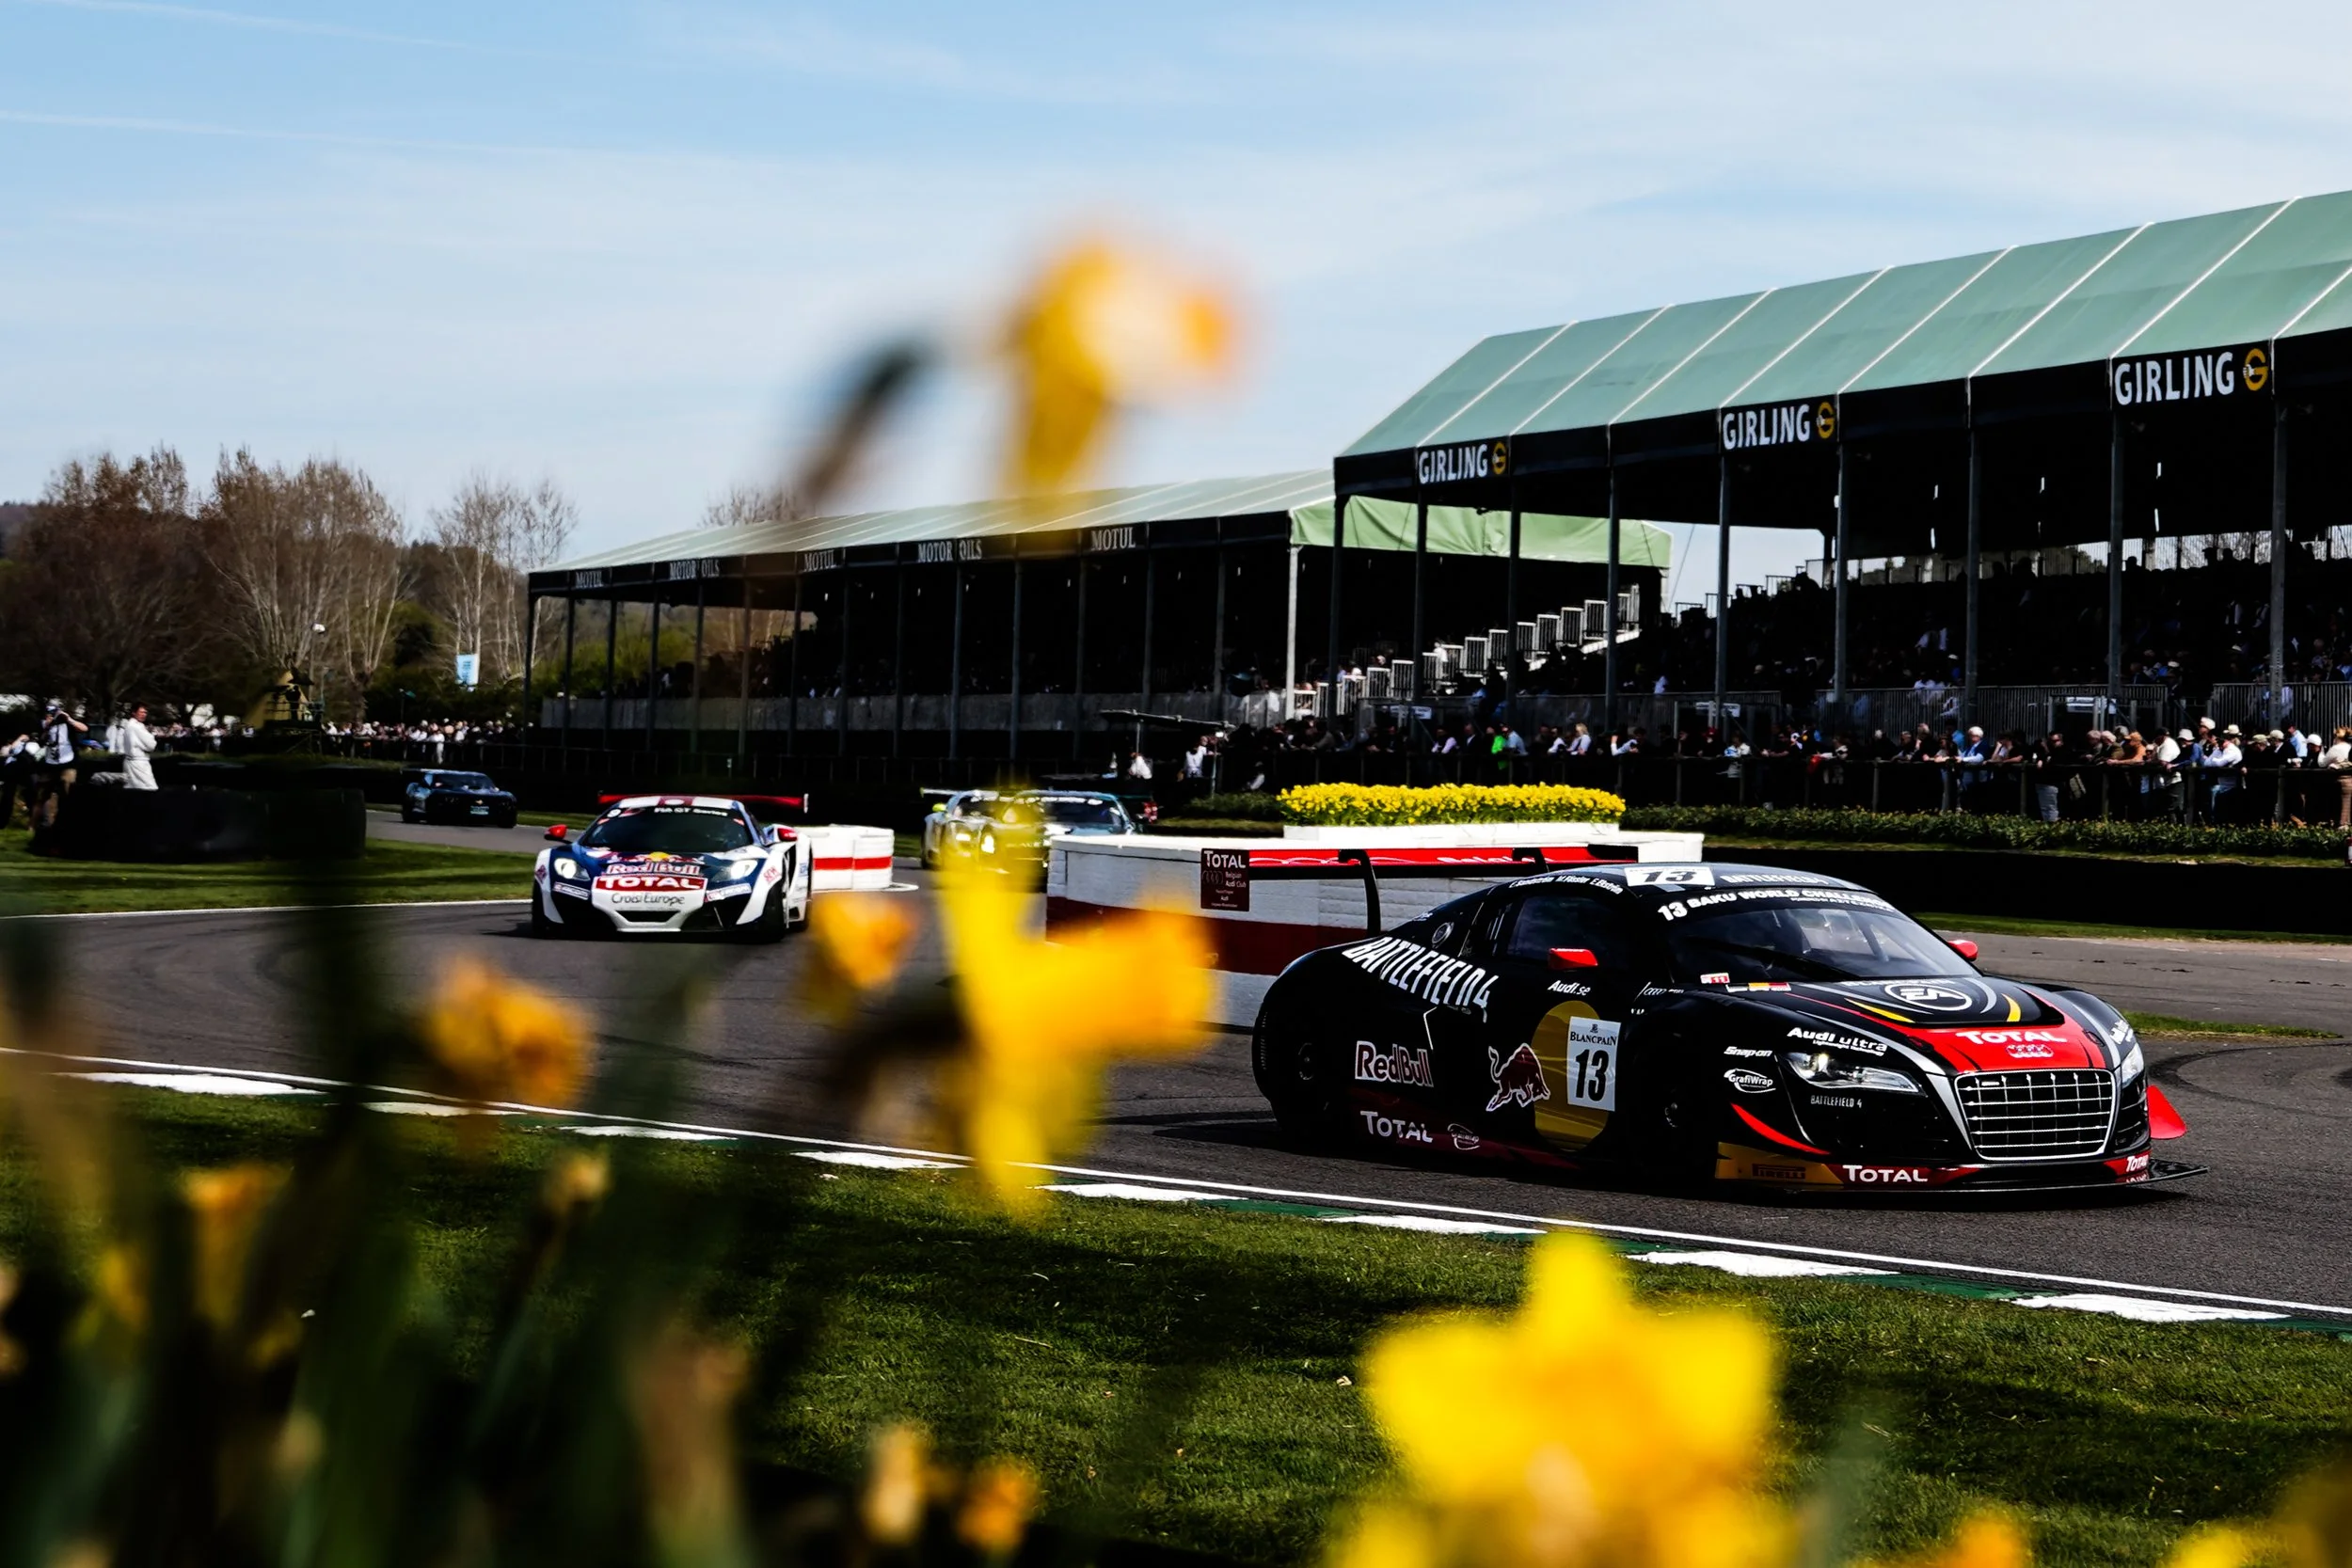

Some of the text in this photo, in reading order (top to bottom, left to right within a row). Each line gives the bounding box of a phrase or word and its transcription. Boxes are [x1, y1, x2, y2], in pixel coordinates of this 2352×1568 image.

[2115, 352, 2234, 405] GIRLING
[1723, 404, 1810, 450] GIRLING
[1419, 444, 1487, 484] GIRLING
[1090, 527, 1136, 551] MOTUL
[804, 550, 835, 571] MOTUL
[917, 538, 982, 563] MOTOR OILS
[669, 558, 721, 580] MOTOR OILS
[1203, 850, 1247, 869] TOTAL
[598, 876, 702, 889] TOTAL
[1644, 871, 1697, 882] 13
[1658, 901, 1687, 921] 13
[1687, 892, 1737, 908] BAKU
[1738, 889, 1801, 900] WORLD
[1548, 980, 1591, 996] Audi.se
[1569, 1030, 1617, 1046] BLANCPAIN
[1787, 1027, 1887, 1053] Audi ultra
[1955, 1031, 2067, 1044] TOTAL
[1574, 1048, 1610, 1102] 13
[1728, 1073, 1773, 1087] GrafiWrap
[1810, 1095, 1862, 1109] BATTLEFIELD 4
[1360, 1110, 1433, 1143] TOTAL
[1842, 1164, 1928, 1182] TOTAL
